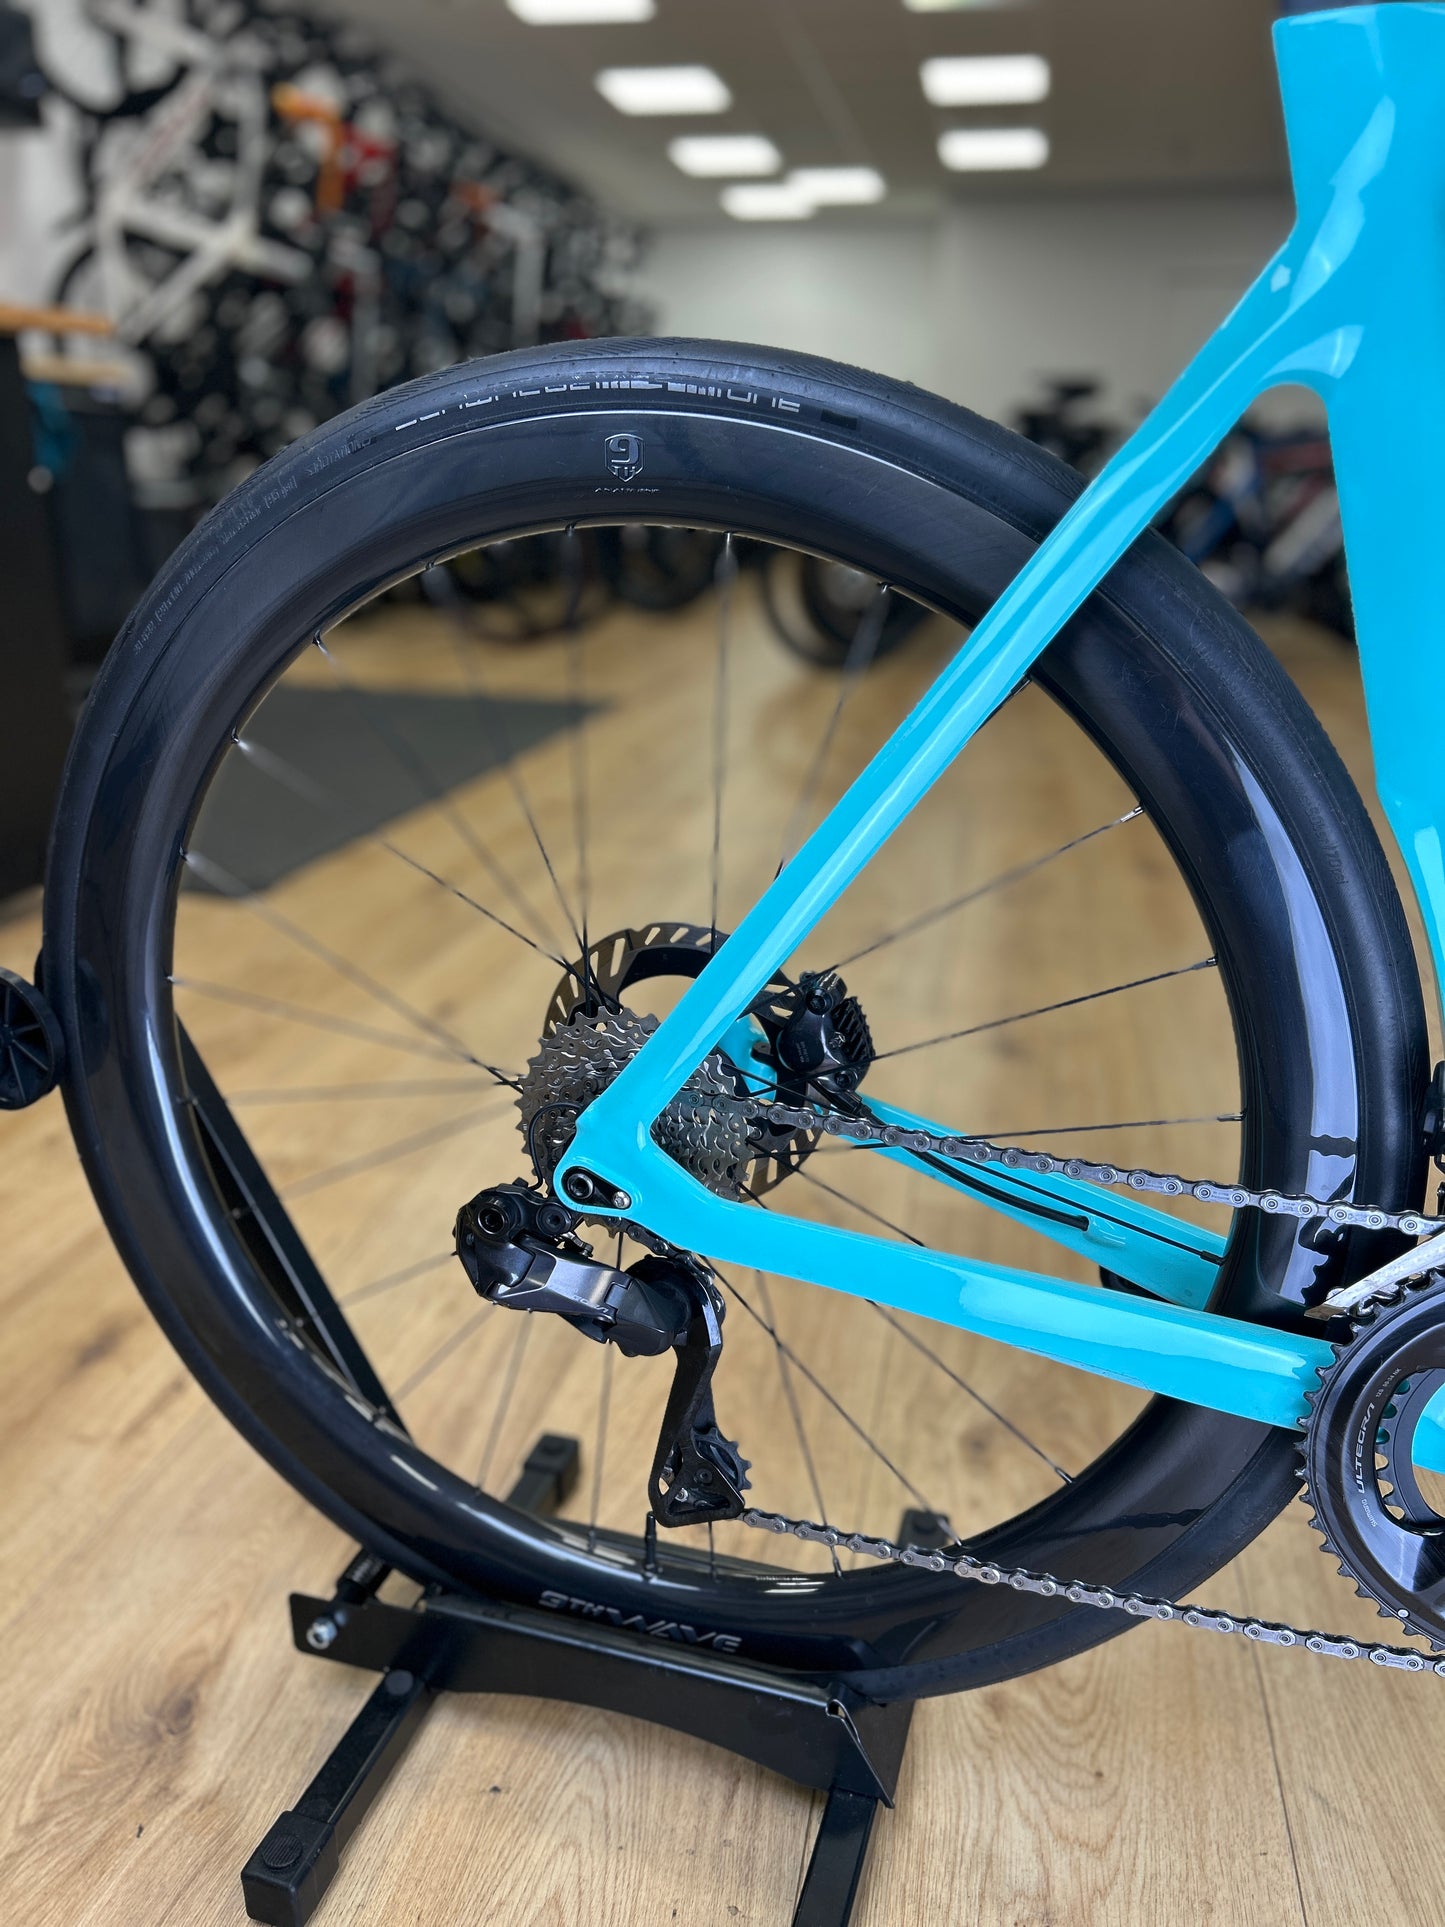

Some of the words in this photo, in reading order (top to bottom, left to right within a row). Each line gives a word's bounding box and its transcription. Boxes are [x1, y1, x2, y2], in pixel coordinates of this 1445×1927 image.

[608, 437, 639, 465] 9
[1355, 1402, 1375, 1494] ULTEGRA
[1361, 1498, 1378, 1528] SHIMANO
